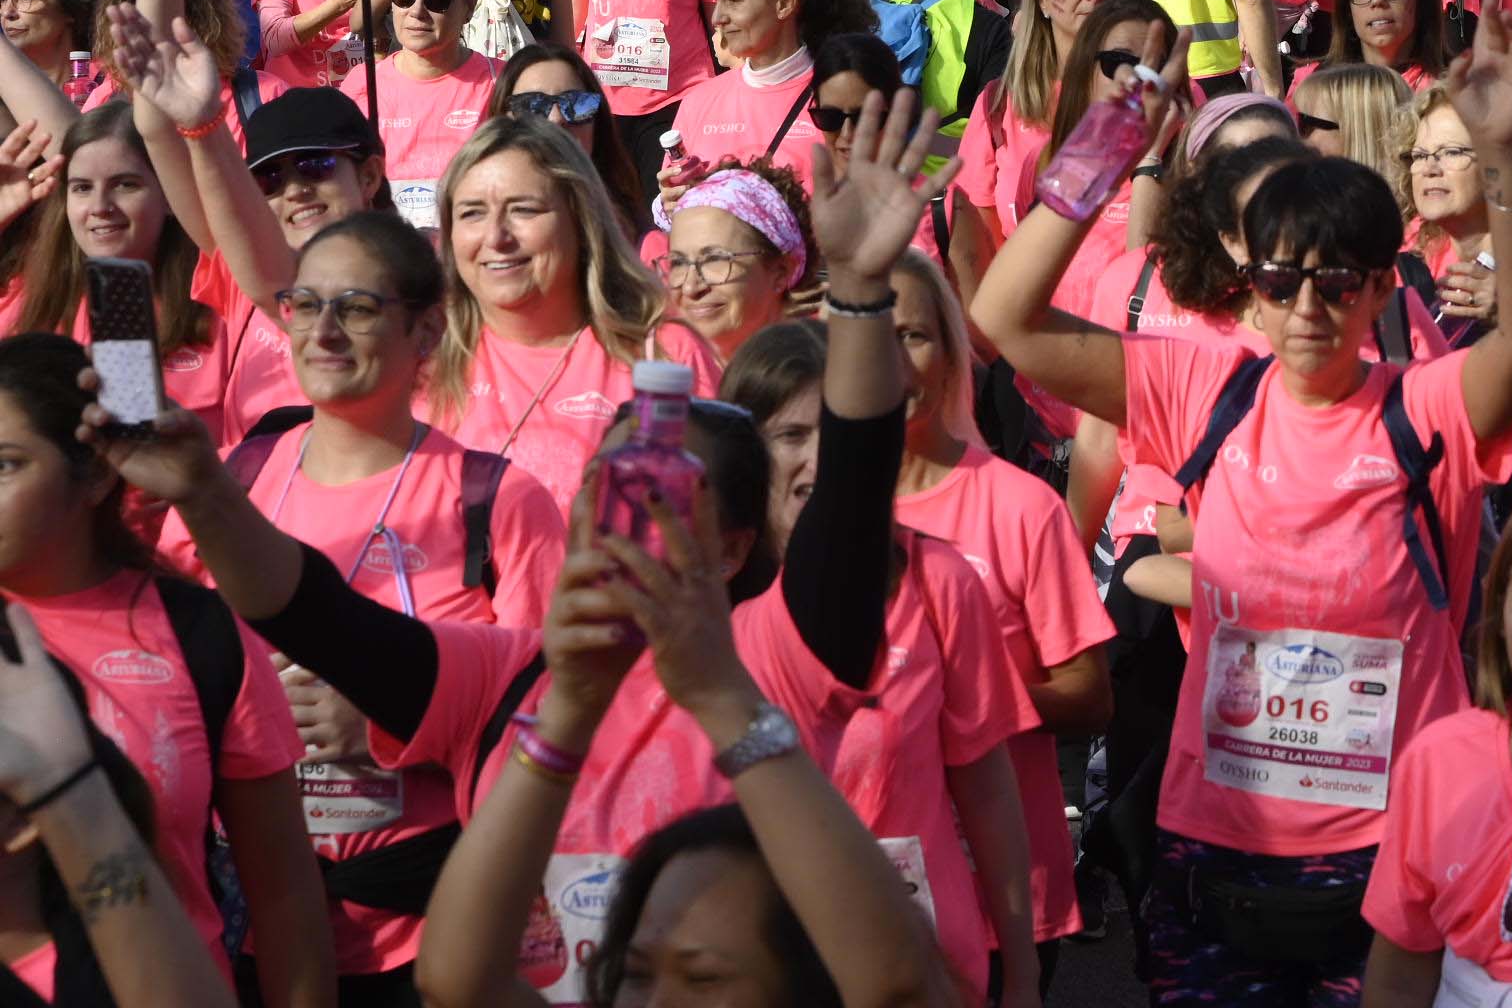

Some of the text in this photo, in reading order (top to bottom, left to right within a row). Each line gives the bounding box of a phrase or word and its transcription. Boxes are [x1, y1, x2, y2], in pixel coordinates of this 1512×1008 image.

[592, 0, 611, 17] TU
[617, 44, 643, 56] 016
[351, 56, 364, 67] 01
[703, 123, 745, 136] OYSHO
[1137, 314, 1192, 328] OYSHO
[1273, 655, 1337, 676] ASTURIANA
[1266, 695, 1331, 723] 016
[1269, 726, 1319, 745] 26038
[1224, 739, 1372, 769] CARRERA DE LA MUJER 2023
[1219, 761, 1374, 793] OYSHO Santander
[312, 784, 353, 794] MUJER
